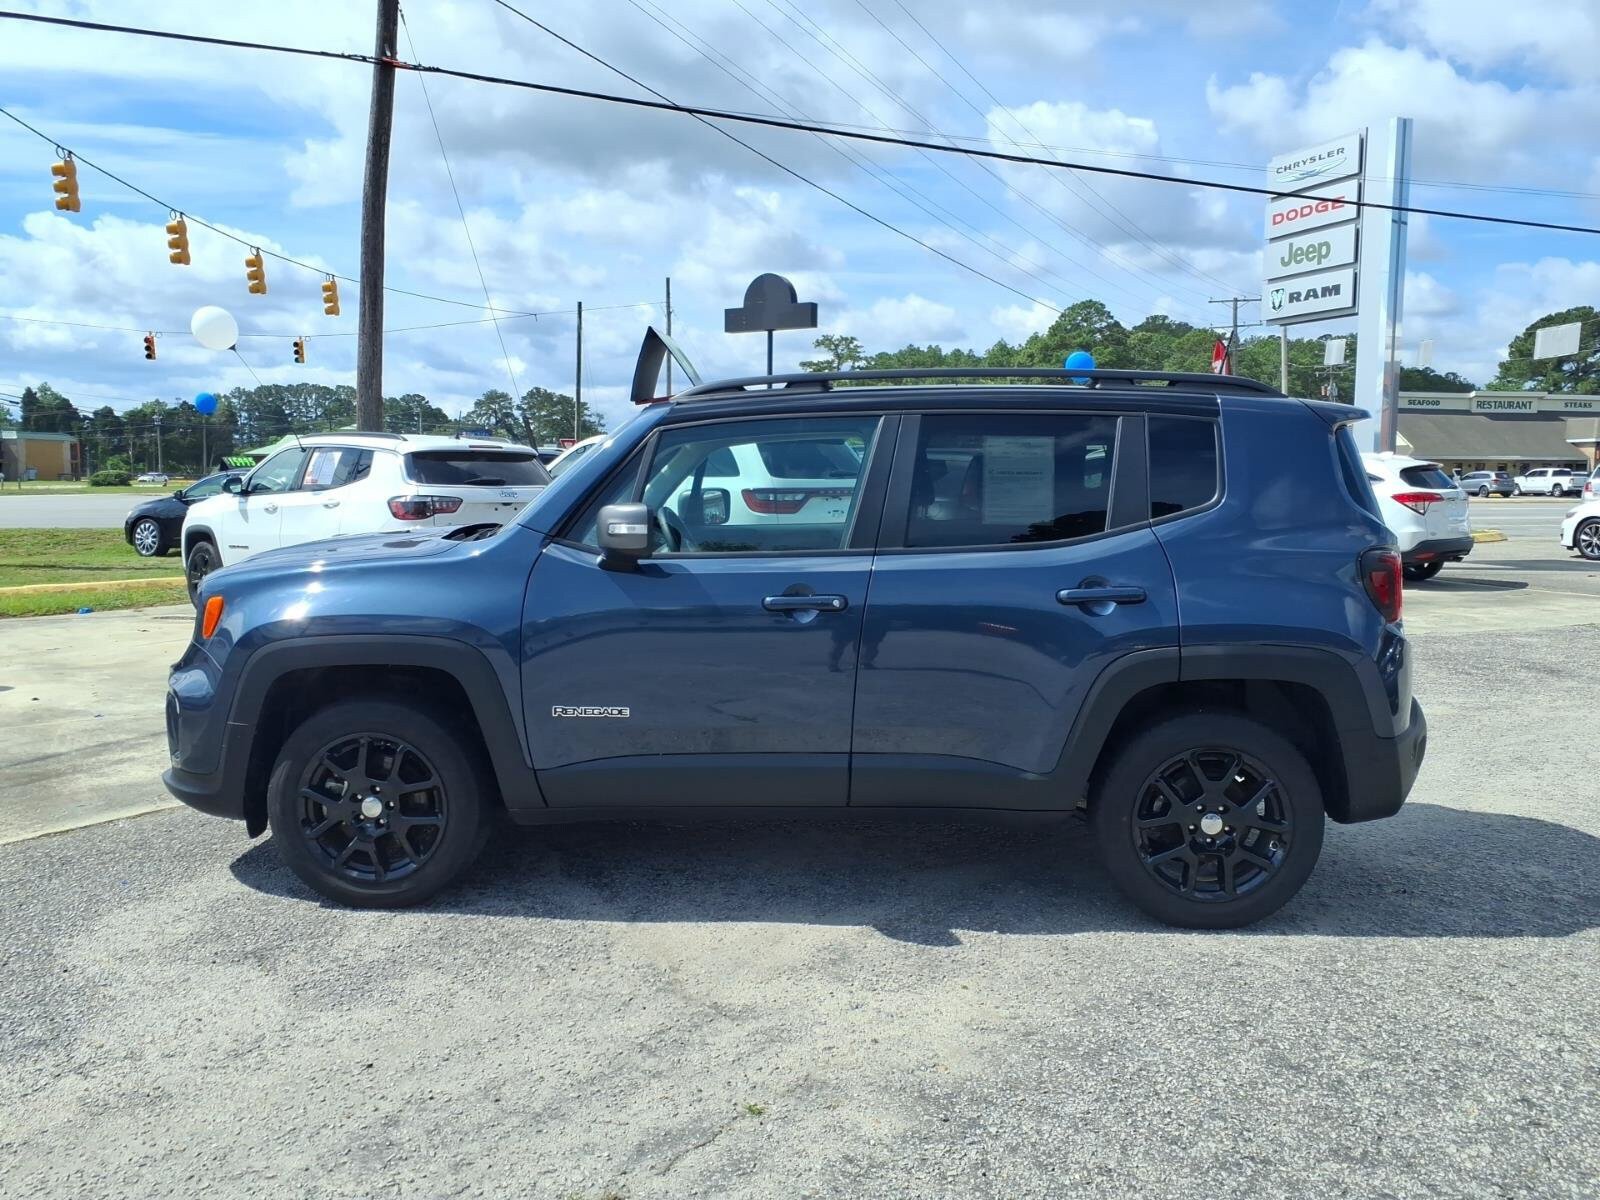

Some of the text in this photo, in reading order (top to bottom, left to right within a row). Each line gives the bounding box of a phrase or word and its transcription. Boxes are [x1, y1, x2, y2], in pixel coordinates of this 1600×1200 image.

[1276, 147, 1345, 174] CHRYSLER
[1272, 195, 1345, 226] DODGE
[1280, 240, 1331, 267] Jeep
[1288, 284, 1341, 304] RAM
[1407, 399, 1440, 407] SEAFOOD
[1476, 400, 1533, 410] RESTAURANT
[1563, 401, 1593, 409] STEAKS
[552, 705, 630, 717] RENEGADE
